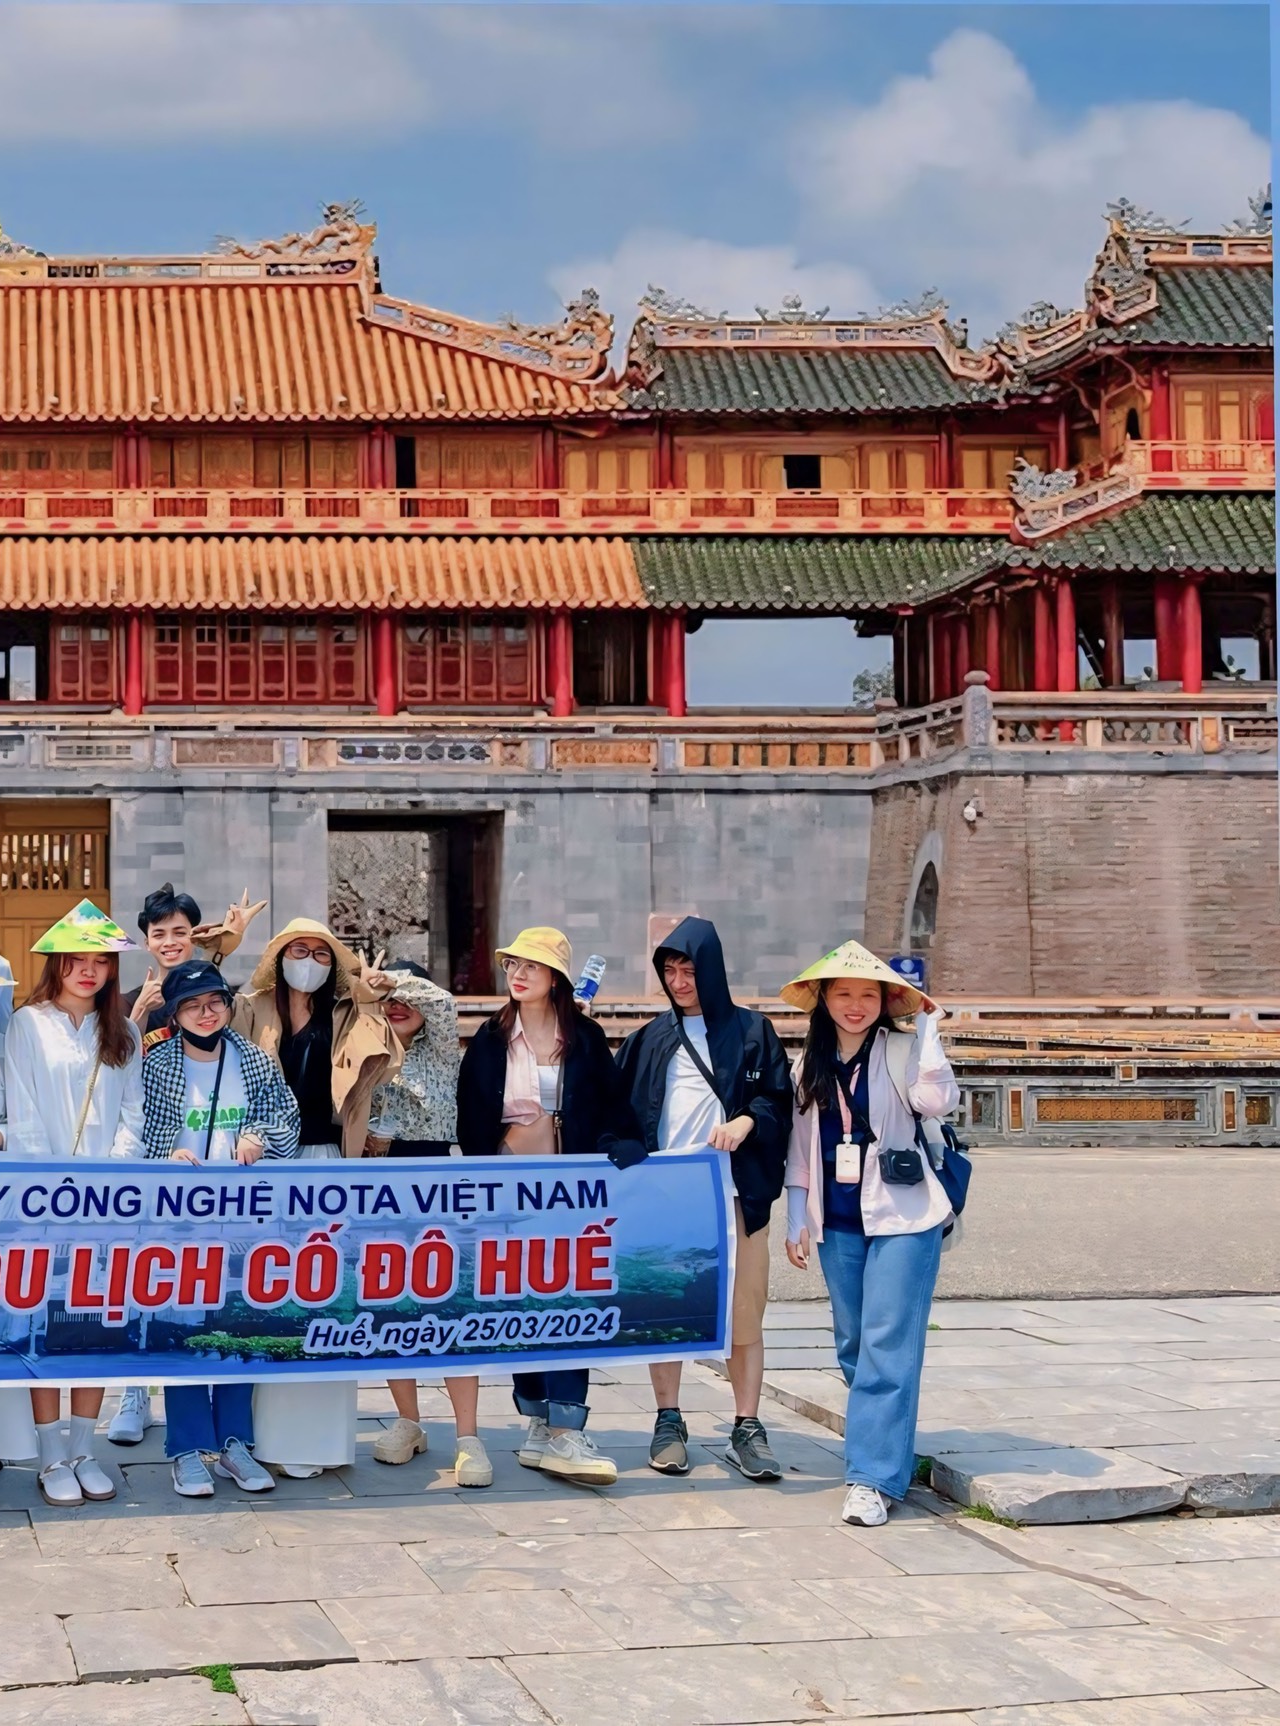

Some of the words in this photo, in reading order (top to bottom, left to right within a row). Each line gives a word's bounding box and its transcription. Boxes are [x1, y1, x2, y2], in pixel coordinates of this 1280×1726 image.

[186, 1108, 202, 1132] 4
[21, 1177, 141, 1217] CÔNG
[156, 1180, 273, 1223] NGHỆ
[288, 1184, 401, 1216] NOTA
[412, 1178, 503, 1219] VIỆT
[517, 1179, 608, 1210] NAM
[70, 1246, 224, 1321] LỊCH
[248, 1223, 343, 1303] CỐ
[361, 1229, 454, 1300] ĐÔ
[479, 1217, 618, 1295] HUẾ
[309, 1317, 372, 1350] Huế,
[383, 1319, 456, 1349] ngày
[463, 1311, 616, 1342] 25/03/2024
